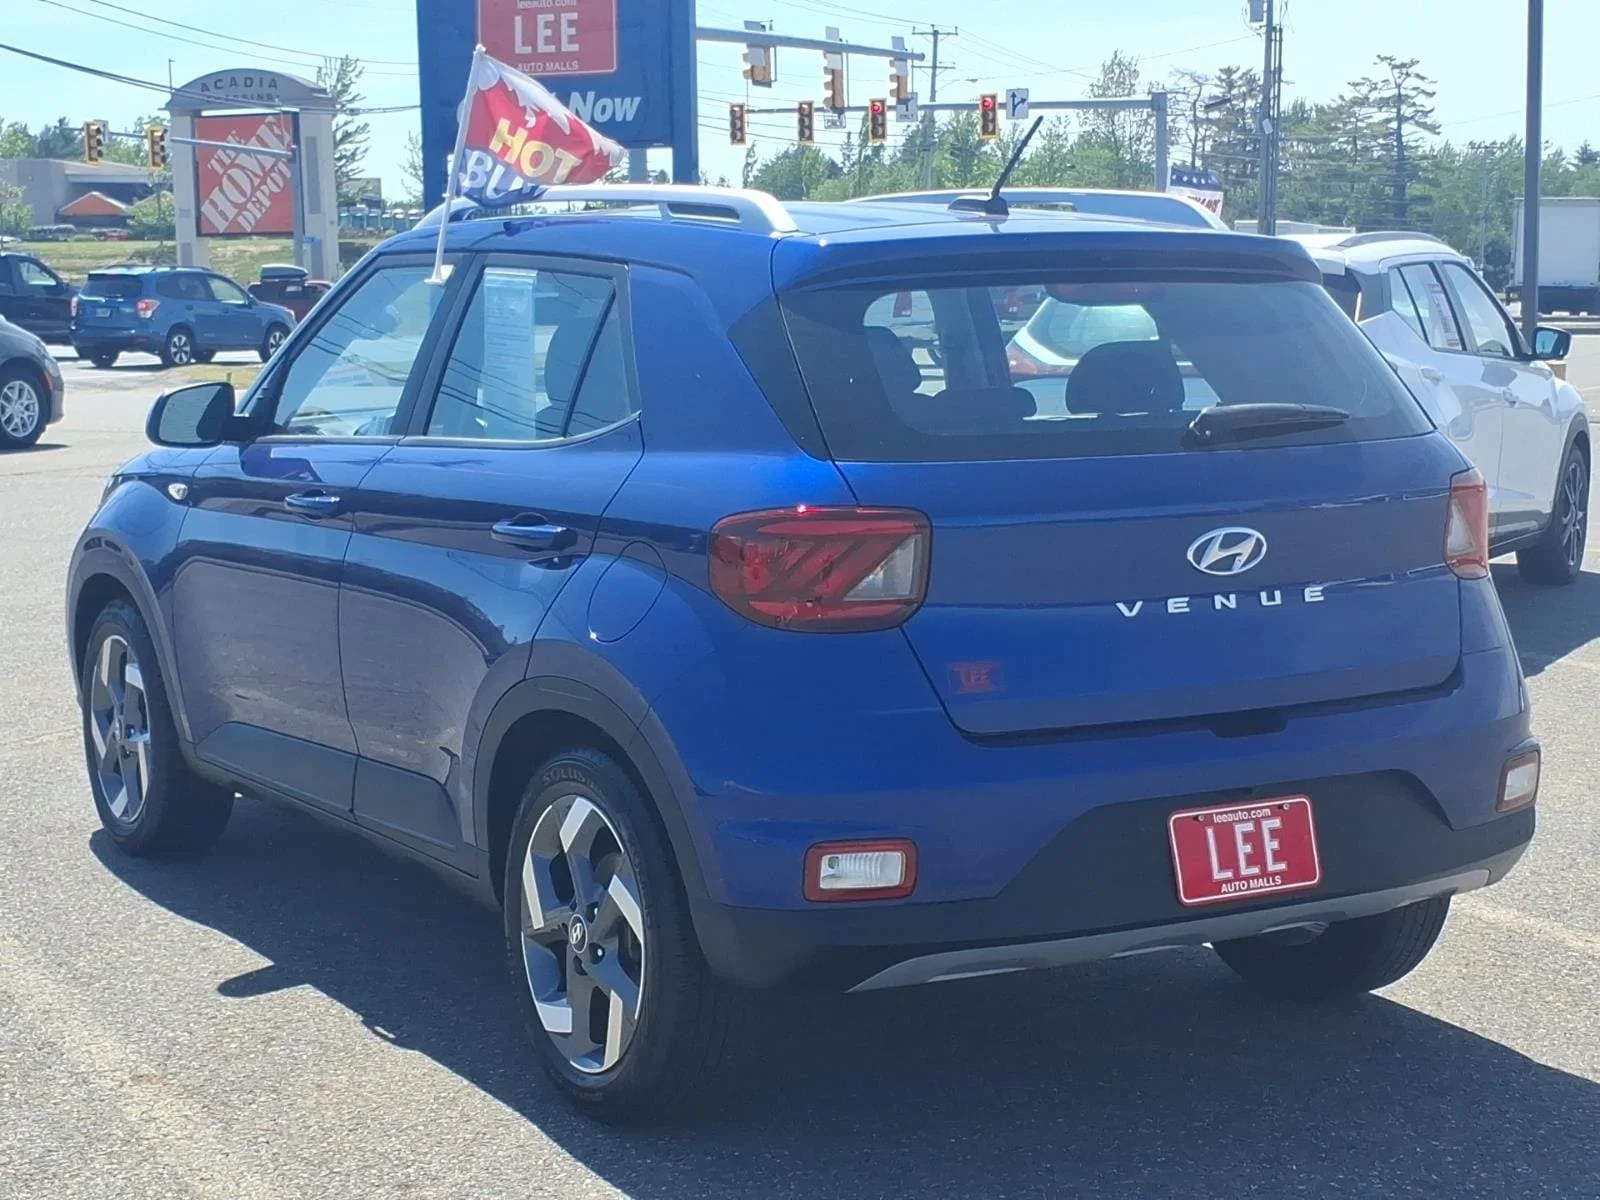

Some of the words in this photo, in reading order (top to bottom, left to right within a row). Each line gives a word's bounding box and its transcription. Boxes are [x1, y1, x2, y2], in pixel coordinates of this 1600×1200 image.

[514, 12, 580, 54] LEE
[517, 62, 543, 73] AUTO
[546, 60, 579, 72] MALLS
[201, 76, 278, 92] ACADIA
[489, 117, 583, 184] HOT
[236, 157, 292, 233] DEPOT
[1116, 586, 1324, 617] VENUE
[1213, 808, 1271, 824] leeauto.com
[1205, 818, 1287, 882] LEE
[1221, 880, 1248, 894] AUTO
[1249, 875, 1282, 889] MALLS
